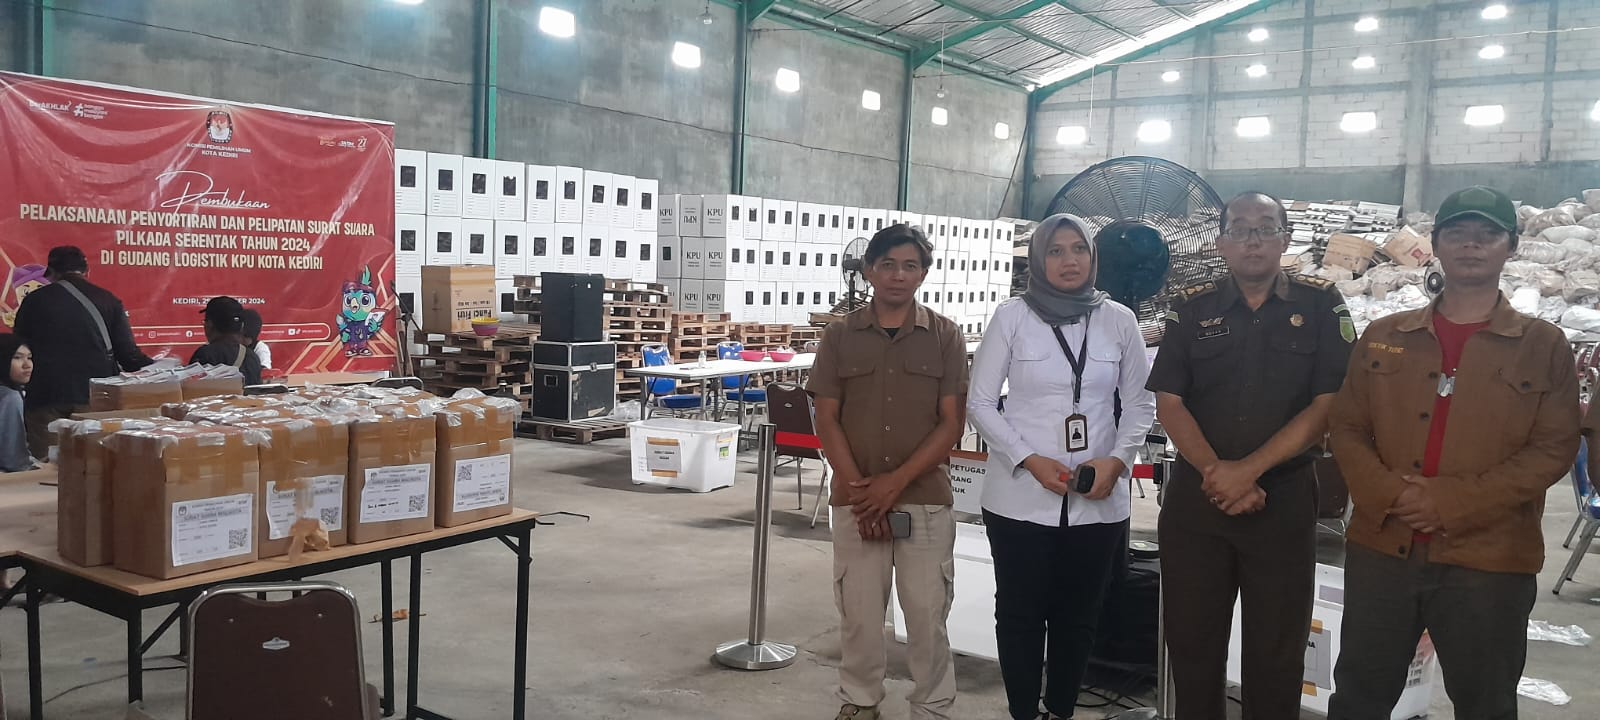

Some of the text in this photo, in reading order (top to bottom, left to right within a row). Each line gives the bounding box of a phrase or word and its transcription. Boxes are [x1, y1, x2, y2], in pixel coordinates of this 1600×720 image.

[155, 170, 271, 213] Pembukaan
[659, 208, 673, 217] KPU
[707, 208, 723, 217] KPU
[20, 203, 376, 237] PELAKSANAAN PENYORTIRAN DAN PELIPATAN SURAT SUARA
[683, 215, 697, 224] KPU
[116, 230, 311, 252] PILKADA SERENTAK TAHUN 2024
[101, 249, 323, 270] DI GUDANG LOGISTIK KPU KOTA KEDIRI
[686, 251, 701, 260] KPU
[708, 251, 723, 260] KPU
[172, 297, 201, 306] KEDIRI,
[248, 297, 265, 305] 2024
[684, 293, 698, 301] KPU
[706, 293, 721, 302] KPU
[951, 463, 987, 475] PETUGAS
[951, 475, 972, 484] RANG
